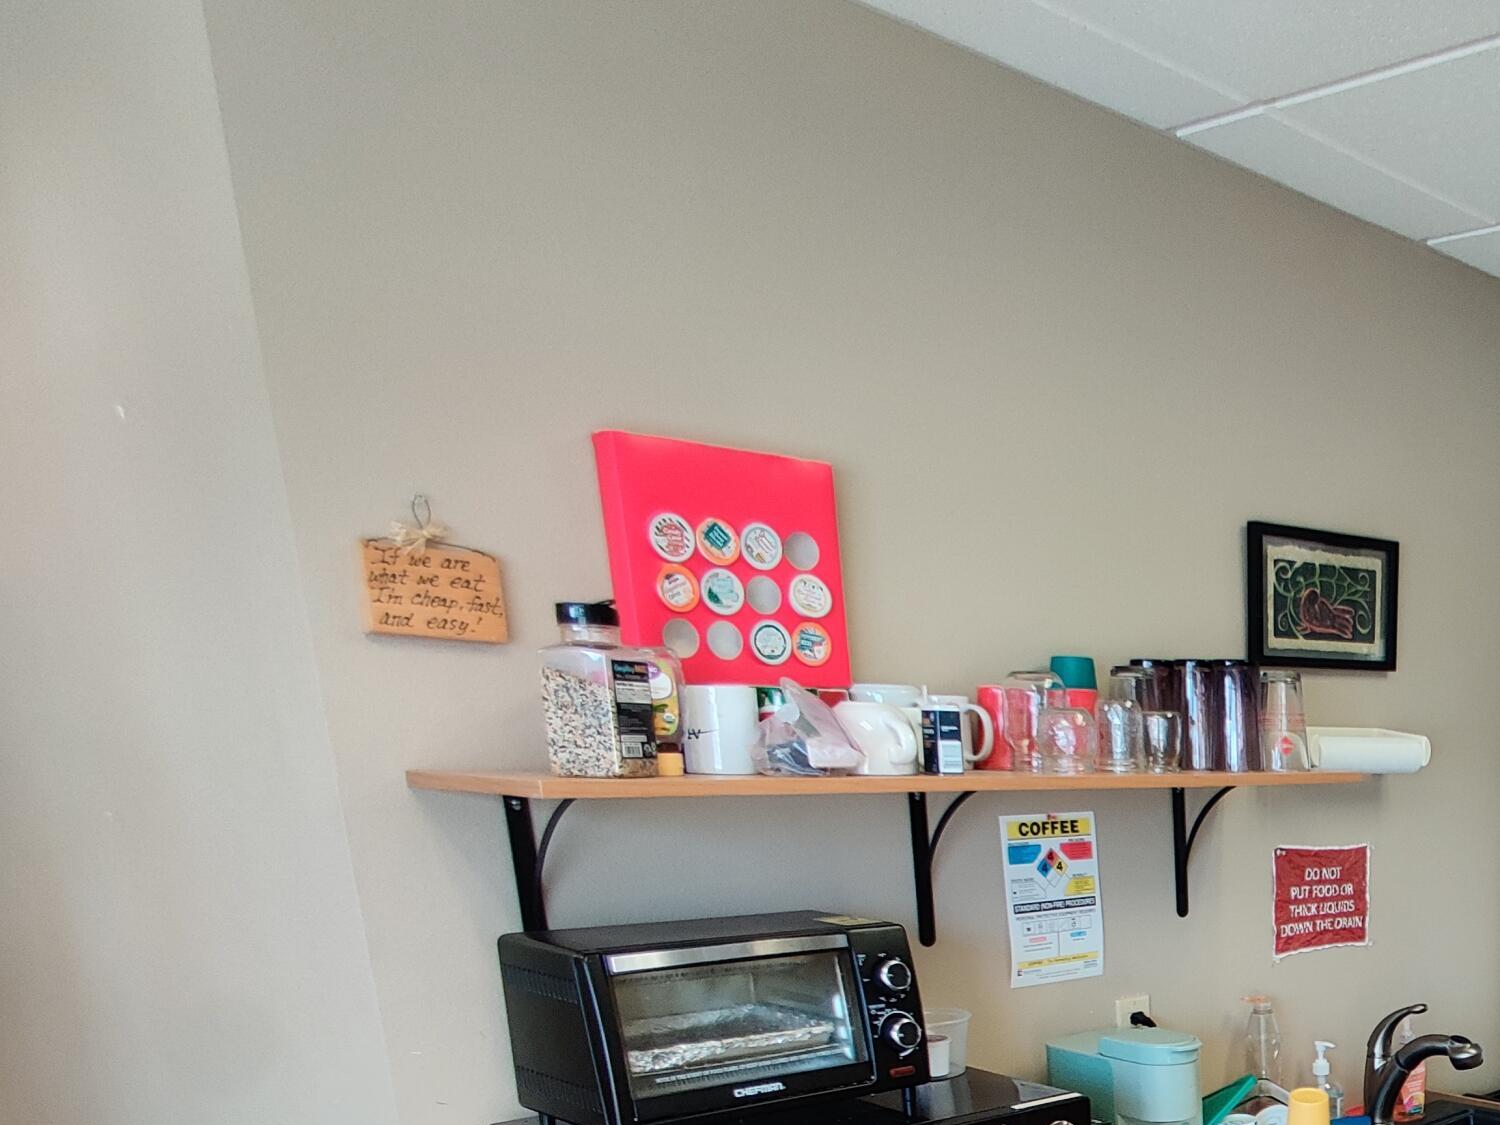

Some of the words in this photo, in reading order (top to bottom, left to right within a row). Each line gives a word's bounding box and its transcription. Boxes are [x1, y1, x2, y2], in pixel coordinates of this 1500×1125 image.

[370, 546, 401, 566] If
[408, 554, 431, 568] we
[440, 557, 471, 572] are
[368, 568, 409, 585] what
[416, 574, 440, 588] we
[449, 574, 486, 593] eat
[379, 612, 414, 628] and
[1018, 820, 1080, 837] COFFEE
[1056, 861, 1063, 871] 4
[1305, 868, 1320, 881] DO
[1321, 867, 1342, 880] NOT
[1290, 886, 1311, 900] PUT
[1312, 884, 1339, 898] FOOD
[1340, 883, 1354, 895] OR
[1289, 903, 1318, 918] THICK
[1319, 900, 1355, 915] LIQUIDS
[1280, 921, 1314, 938] DOWN
[1316, 918, 1334, 931] THE
[1334, 915, 1363, 929] DRAIN
